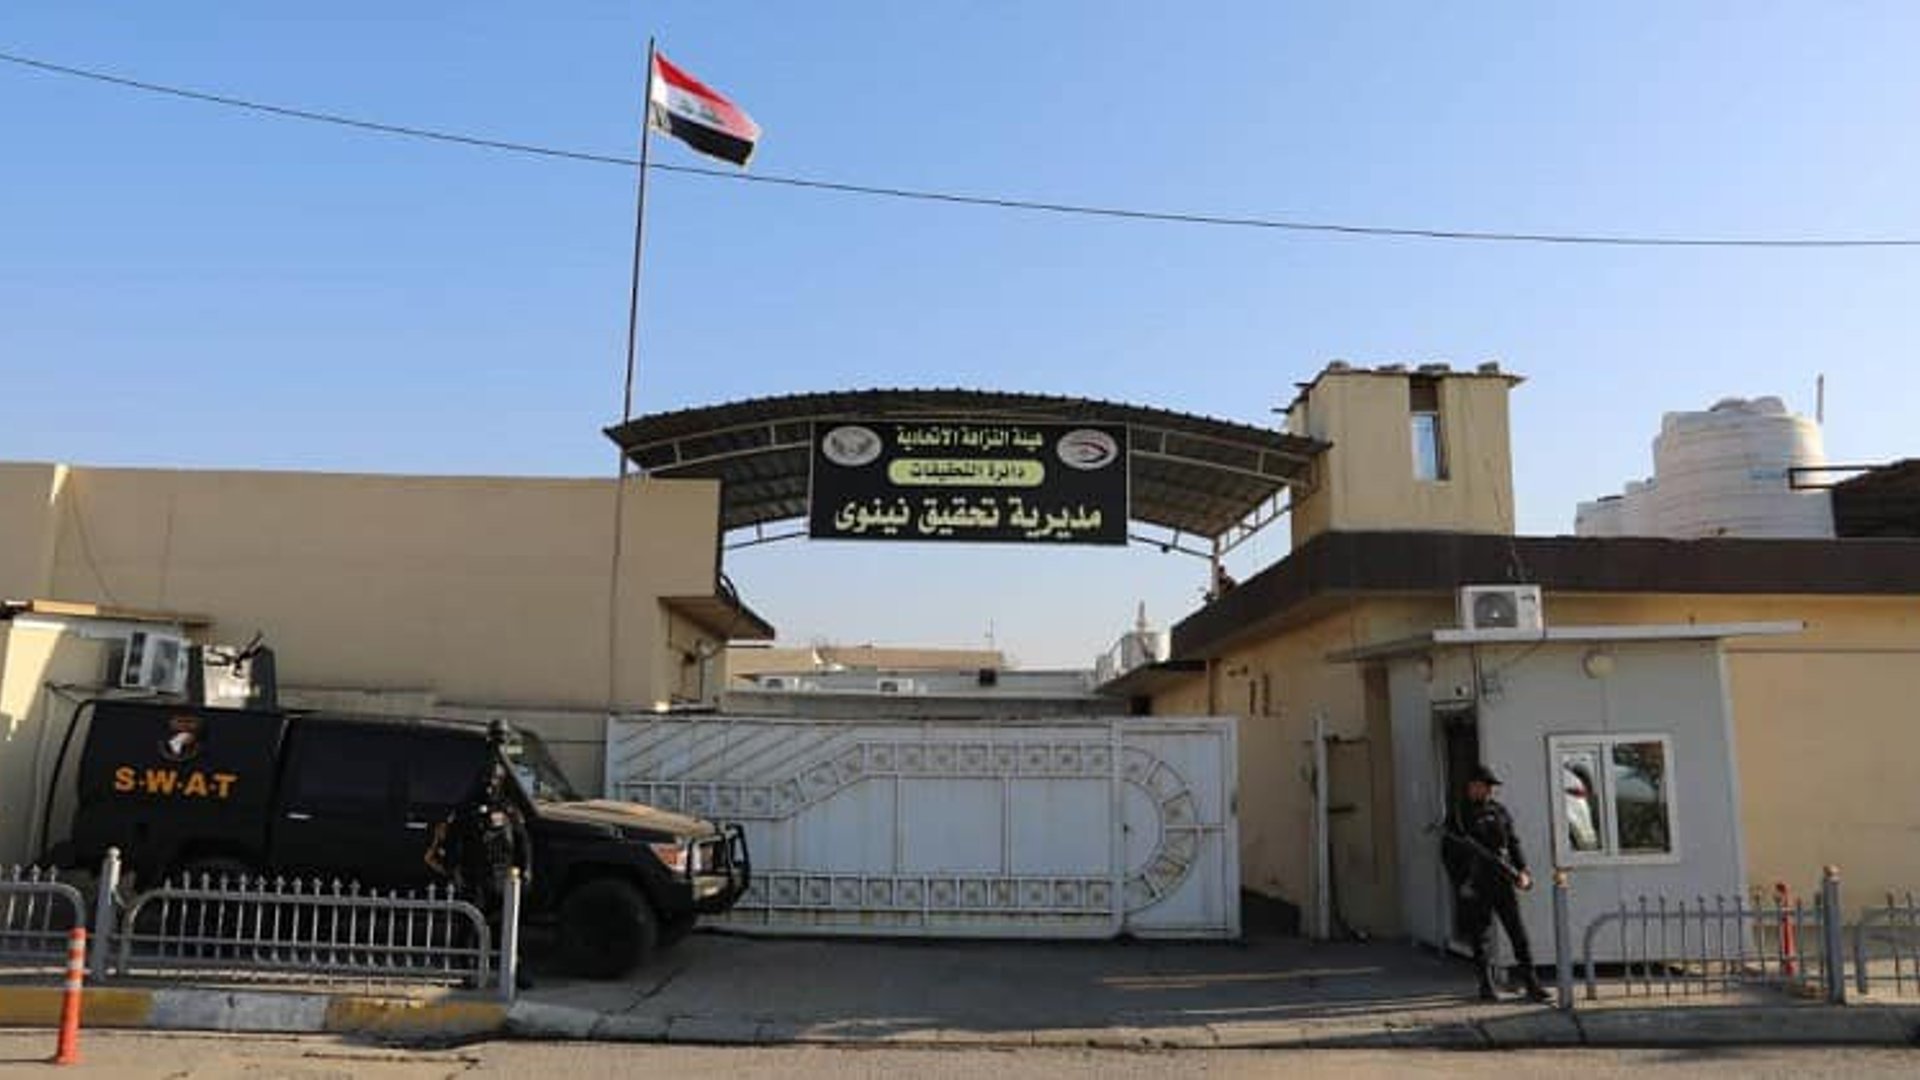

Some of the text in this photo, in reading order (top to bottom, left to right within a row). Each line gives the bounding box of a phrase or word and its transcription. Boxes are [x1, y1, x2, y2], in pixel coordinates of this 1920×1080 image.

[960, 426, 1009, 451] النزاهة
[835, 496, 1102, 538] مديرية تحقيق نينوى
